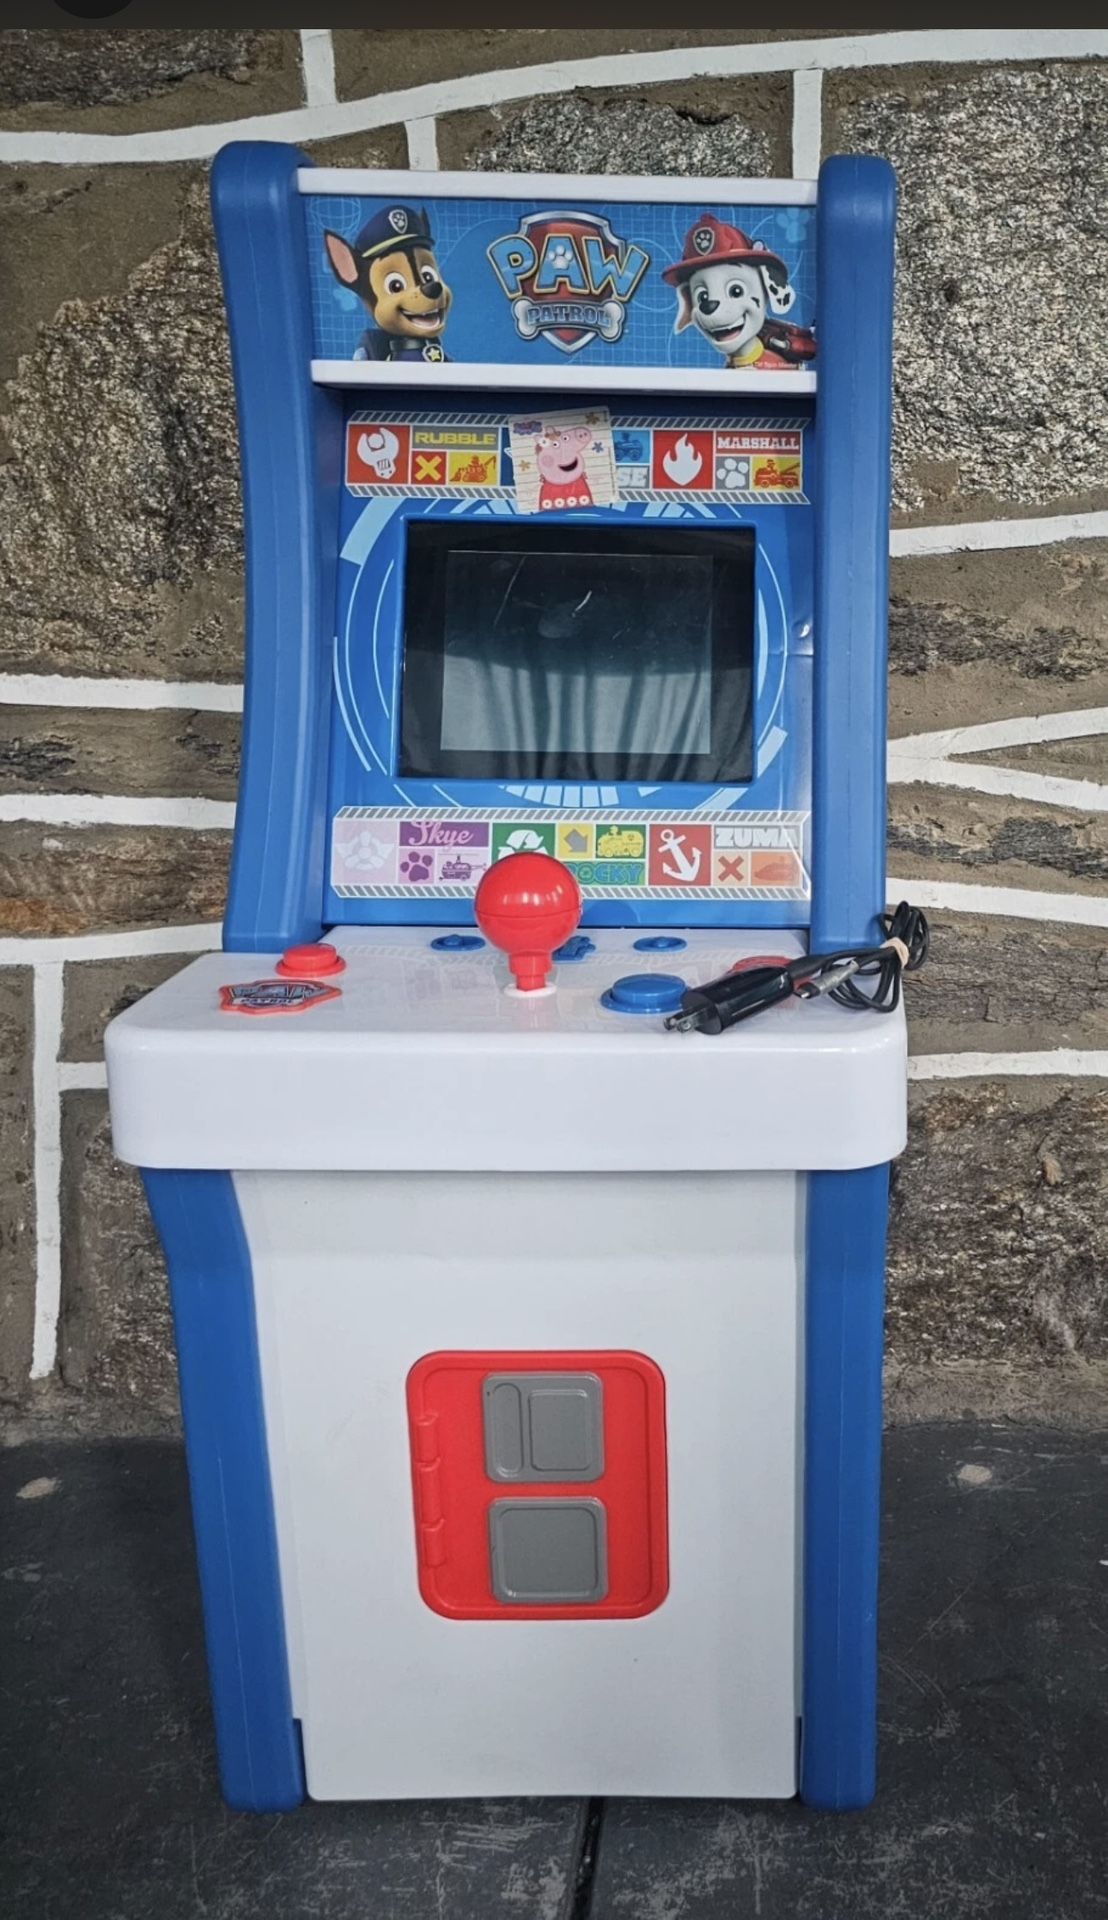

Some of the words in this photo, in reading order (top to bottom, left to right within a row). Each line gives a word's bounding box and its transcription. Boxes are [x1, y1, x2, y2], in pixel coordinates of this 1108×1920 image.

[486, 233, 649, 302] PAW
[527, 304, 614, 328] PATROL
[415, 432, 497, 445] RUBBLE
[717, 437, 799, 450] MARSHALL
[408, 820, 474, 850] Skye
[715, 827, 799, 847] ZUMA
